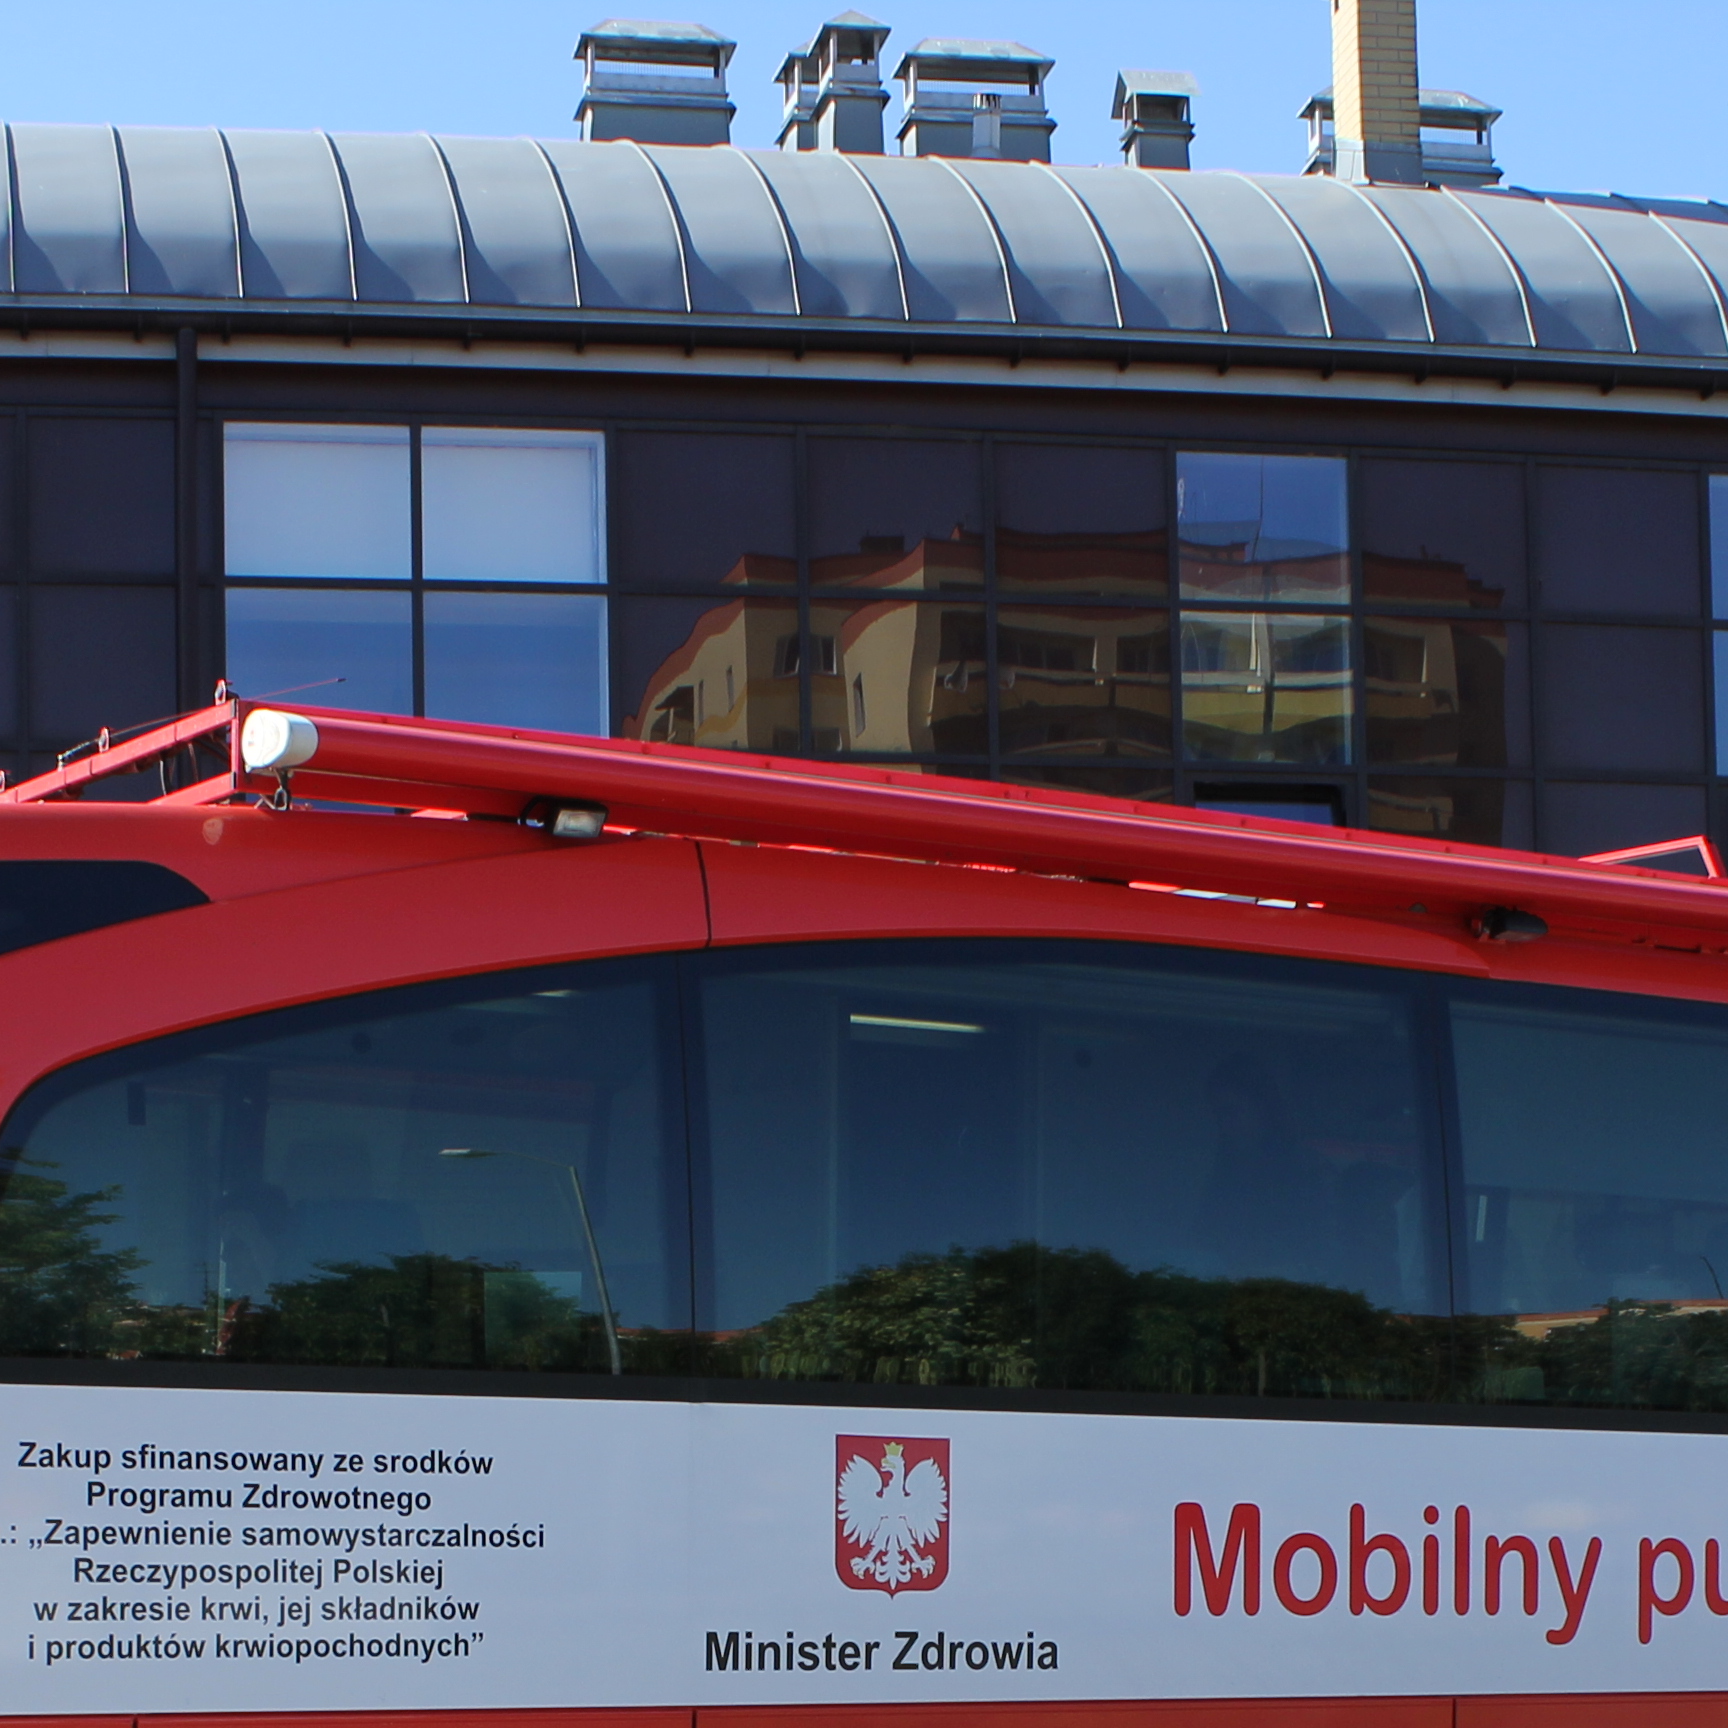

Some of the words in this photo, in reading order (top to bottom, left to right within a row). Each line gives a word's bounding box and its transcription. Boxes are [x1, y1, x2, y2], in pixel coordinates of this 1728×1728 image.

[17, 1441, 112, 1476] Zakup
[121, 1443, 325, 1479] sfinansowany
[332, 1453, 364, 1473] ze
[373, 1449, 494, 1475] srodków
[87, 1481, 232, 1515] Programu
[241, 1483, 432, 1517] Zdrowotnego
[241, 1522, 544, 1554] samowystarczalności
[74, 1557, 323, 1590] Rzeczypospolitej
[333, 1558, 443, 1591] Polskiej
[1173, 1501, 1603, 1646] Mobilny
[33, 1602, 59, 1622] w
[67, 1595, 191, 1622] zakresie
[201, 1595, 269, 1626] krwi,
[276, 1595, 311, 1628] jej
[321, 1595, 480, 1621] składników
[28, 1633, 35, 1660] i
[46, 1632, 206, 1667] produktów
[705, 1631, 881, 1672] Minister
[892, 1631, 1059, 1671] Zdrowia
